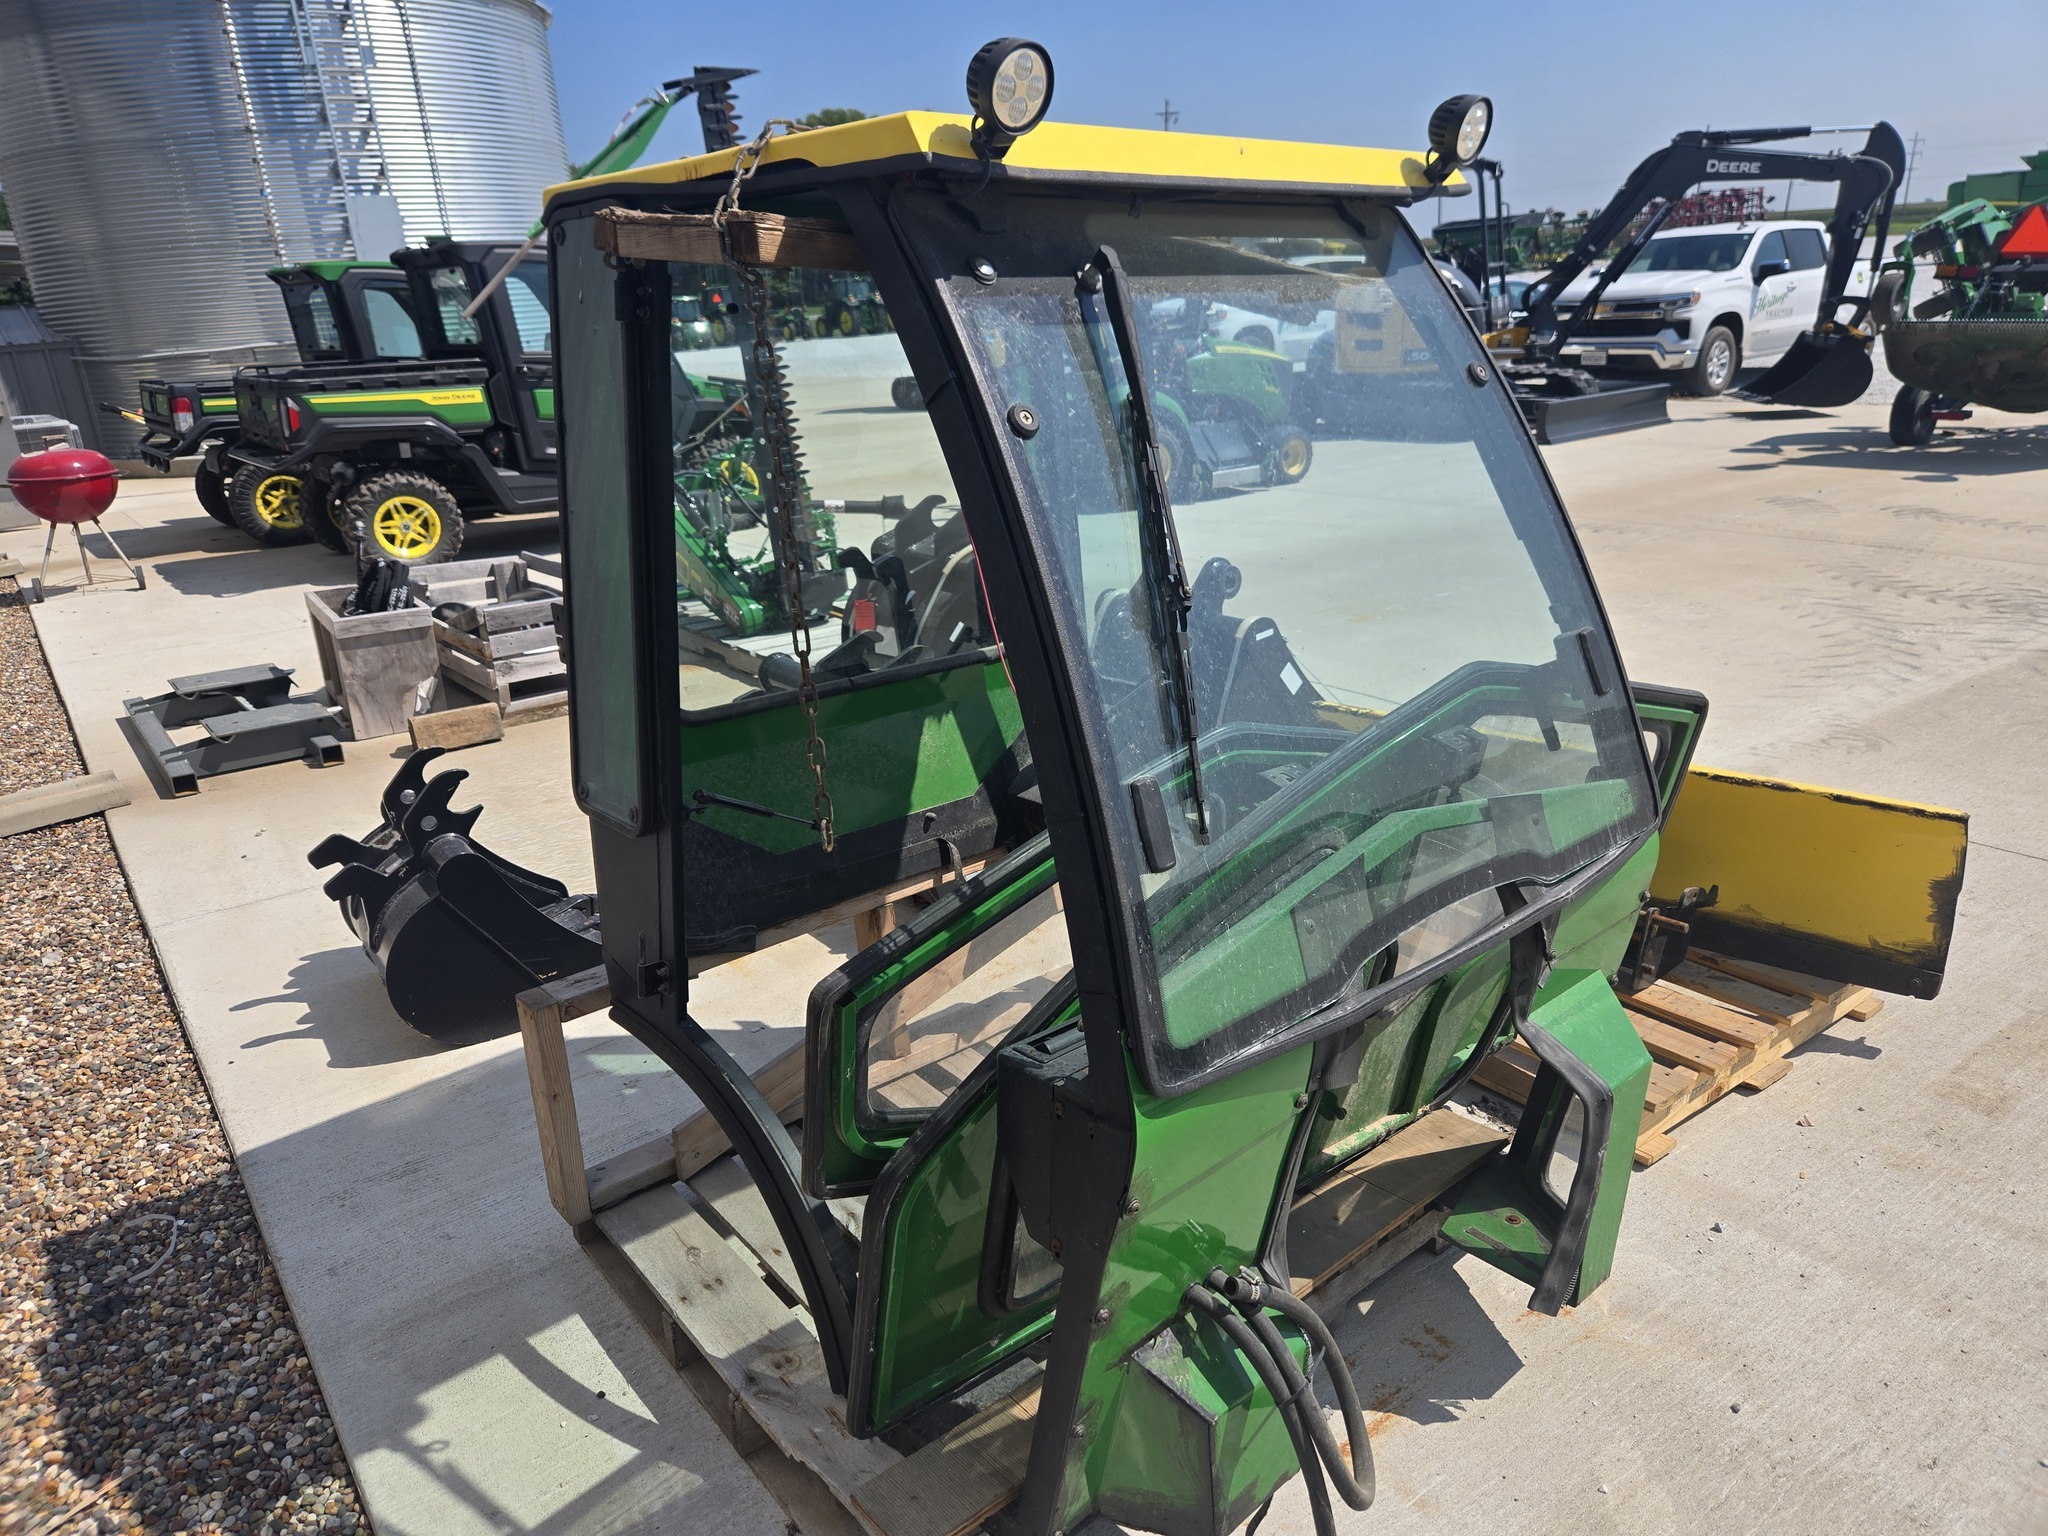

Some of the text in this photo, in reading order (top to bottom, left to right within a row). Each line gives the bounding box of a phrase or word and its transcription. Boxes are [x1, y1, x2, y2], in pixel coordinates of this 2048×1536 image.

[1706, 159, 1761, 174] DEERE
[1755, 292, 1788, 318] Heritage
[1766, 307, 1793, 320] TRACTOR
